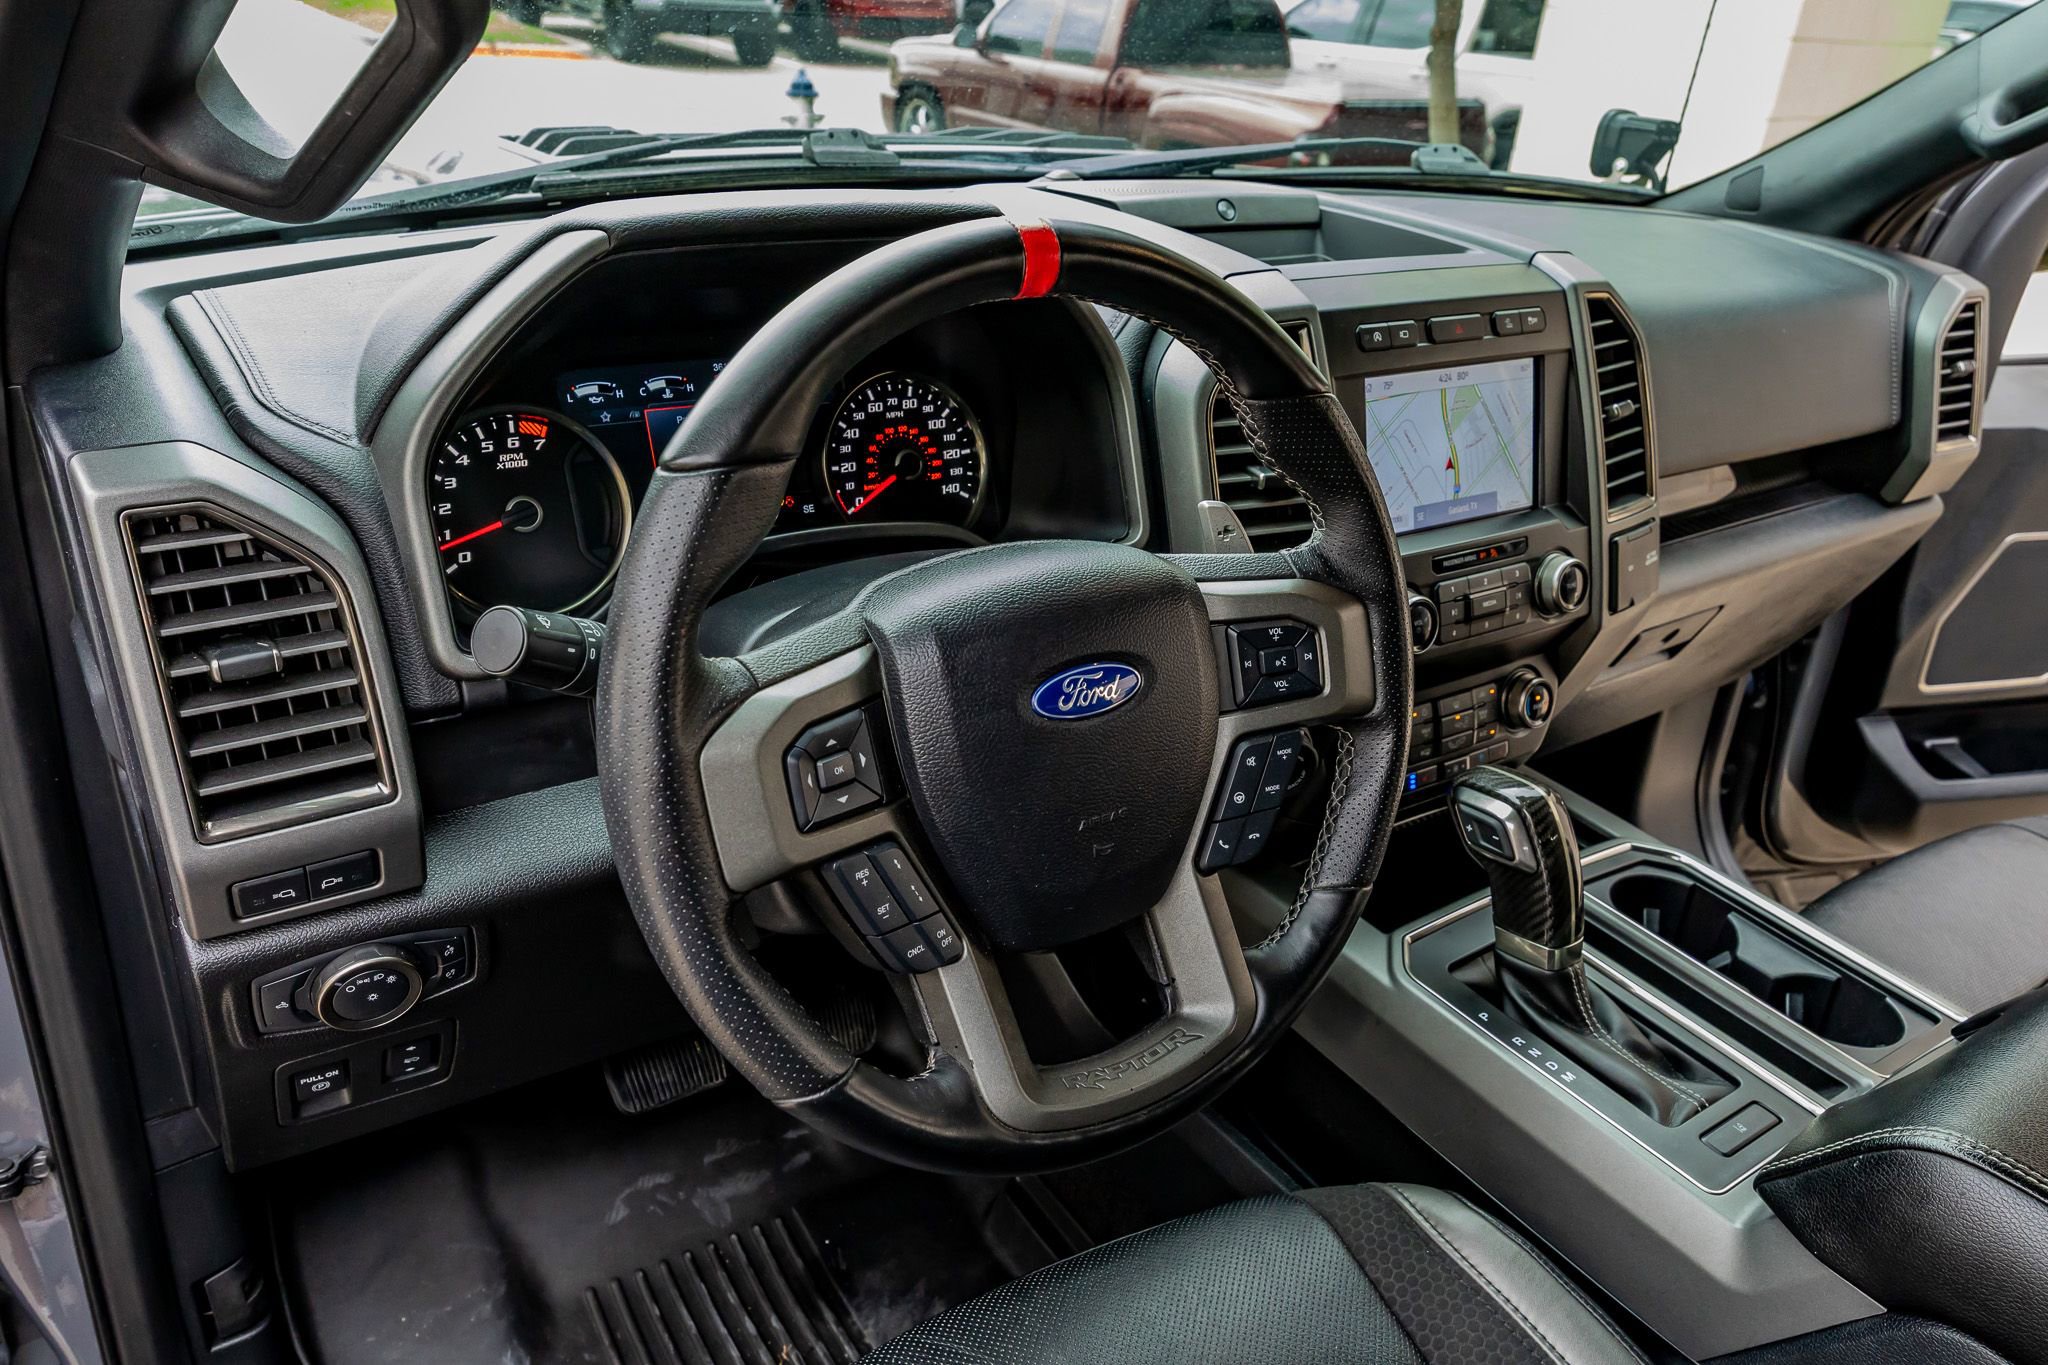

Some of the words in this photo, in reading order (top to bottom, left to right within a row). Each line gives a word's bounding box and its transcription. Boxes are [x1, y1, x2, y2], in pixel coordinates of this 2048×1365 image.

[639, 387, 647, 396] C
[686, 383, 694, 393] H
[566, 394, 573, 403] L
[615, 389, 624, 399] H
[867, 402, 883, 413] 60
[886, 398, 898, 406] 70
[902, 399, 917, 409] 80
[922, 405, 934, 413] 90
[853, 412, 865, 421] 50
[885, 411, 904, 419] MPH
[927, 418, 946, 430] 100
[842, 428, 860, 439] 40
[943, 434, 956, 442] 110
[481, 440, 494, 453] 5
[507, 437, 520, 449] 6
[533, 438, 546, 450] 7
[839, 445, 851, 453] 30
[943, 449, 960, 460] 120
[455, 454, 470, 466] 4
[499, 452, 524, 462] RPM
[840, 462, 856, 473] 20
[950, 467, 963, 476] 130
[444, 477, 457, 489] 3
[845, 482, 855, 490] 10
[941, 483, 960, 495] 140
[855, 496, 864, 507] 0
[438, 503, 452, 515] 2
[803, 504, 815, 514] SE
[443, 529, 451, 540] 1
[458, 551, 472, 563] 0
[1268, 627, 1284, 635] VOL
[1274, 680, 1289, 688] VOL
[1058, 671, 1121, 712] Ford
[1277, 748, 1292, 756] MODE
[834, 766, 845, 775] OK
[1265, 784, 1280, 792] MODE
[855, 868, 870, 880] RES
[877, 902, 889, 915] SET
[936, 928, 946, 939] ON
[941, 935, 953, 948] OFF
[907, 944, 926, 958] CNCL
[1478, 1012, 1489, 1022] P
[1511, 1036, 1527, 1047] R
[1527, 1047, 1543, 1058] N
[1545, 1061, 1559, 1071] D
[1560, 1071, 1577, 1083] M
[1061, 1027, 1204, 1089] RAPTOR
[300, 1075, 324, 1085] PULL
[325, 1069, 339, 1078] ON
